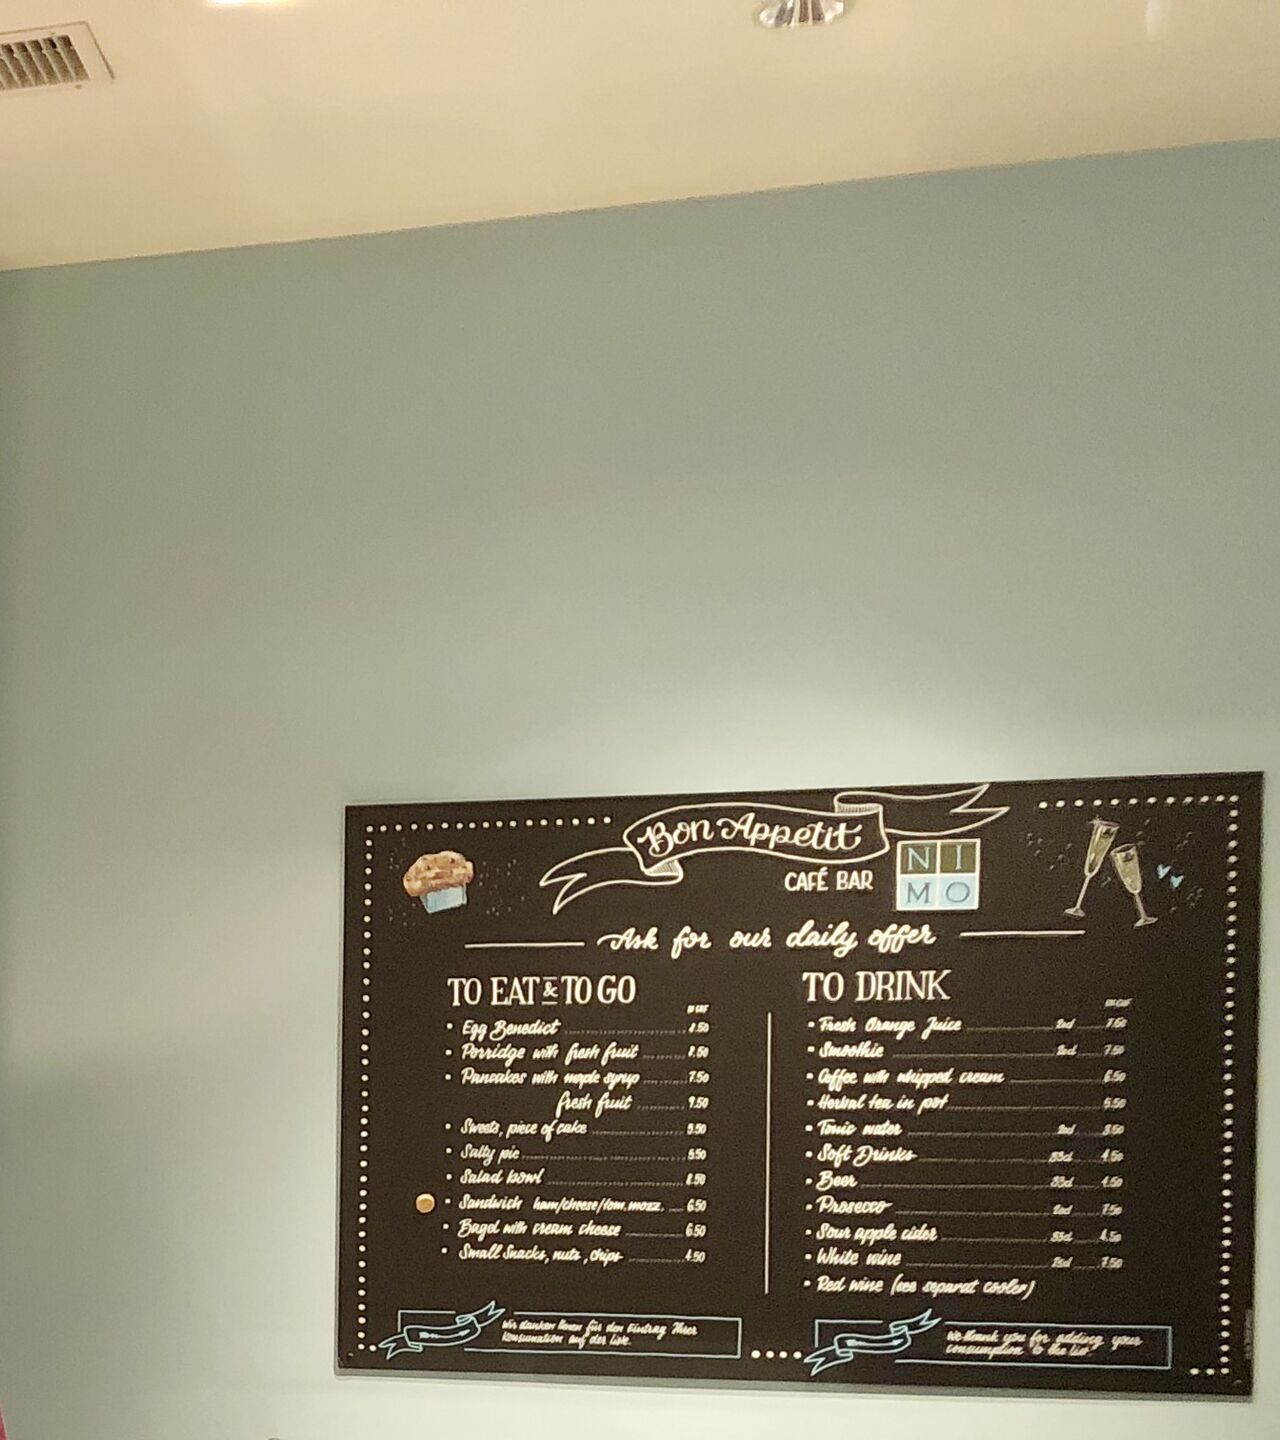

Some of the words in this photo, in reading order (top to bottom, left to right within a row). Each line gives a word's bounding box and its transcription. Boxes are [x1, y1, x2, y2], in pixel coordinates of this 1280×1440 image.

[637, 818, 715, 857] Bon
[716, 812, 863, 851] Appetit
[784, 867, 829, 892] CAFÉ
[836, 870, 874, 891] BAR
[597, 926, 660, 951] Ask
[670, 926, 712, 959] for
[729, 928, 772, 949] our
[785, 919, 858, 958] daily
[867, 923, 937, 953] offer
[447, 977, 482, 1006] TO
[490, 976, 539, 1006] EAT
[542, 979, 559, 999] &
[561, 976, 592, 1006] TO
[597, 975, 636, 1004] GO
[802, 971, 845, 1002] TO
[855, 969, 952, 1002] DRINK
[462, 1020, 487, 1041] Egg
[490, 1018, 561, 1041] Benedict
[818, 1016, 857, 1032] Fresh
[865, 1017, 916, 1040] Orange
[921, 1016, 962, 1040] Juice
[461, 1043, 526, 1067] Porridge
[532, 1045, 559, 1060] with
[565, 1041, 600, 1066] fresh
[601, 1041, 640, 1067] fruit
[818, 1040, 885, 1058] Smoothie
[460, 1067, 527, 1086] Pancakes
[531, 1070, 559, 1085] with
[563, 1070, 600, 1090] maple
[603, 1072, 640, 1091] syrup
[817, 1068, 858, 1092] Coffee
[863, 1069, 890, 1084] with
[896, 1068, 954, 1090] whipped
[958, 1070, 1005, 1084] cream
[556, 1091, 593, 1119] fresh
[595, 1092, 633, 1119] fruit
[817, 1093, 865, 1110] Herbal
[869, 1094, 894, 1110] tea
[896, 1094, 915, 1109] in
[917, 1094, 950, 1116] pot
[460, 1118, 504, 1138] Sweets,
[506, 1122, 538, 1139] piece
[540, 1120, 556, 1142] of
[556, 1120, 588, 1134] cake
[816, 1118, 857, 1136] Tonic
[861, 1119, 903, 1136] water
[460, 1143, 495, 1166] Salty
[497, 1145, 521, 1164] pie
[817, 1143, 852, 1168] Soft
[852, 1145, 918, 1167] Drinks
[459, 1168, 504, 1185] Salad
[506, 1168, 545, 1184] bowl
[815, 1170, 858, 1191] Beer
[458, 1194, 523, 1210] Sandwich
[815, 1194, 893, 1214] Prosecco
[457, 1218, 500, 1241] Bagel
[503, 1220, 528, 1235] with
[532, 1221, 573, 1236] cream
[578, 1220, 622, 1236] cheese
[816, 1222, 851, 1240] Sour
[853, 1222, 897, 1246] apple
[900, 1223, 938, 1241] cider
[458, 1243, 501, 1260] Small
[816, 1246, 859, 1266] White
[865, 1248, 902, 1266] wine
[816, 1275, 846, 1292] Red
[848, 1276, 884, 1292] wine
[982, 1277, 1037, 1300] cooler)
[1003, 1332, 1027, 1347] you
[1030, 1329, 1050, 1347] for
[1055, 1329, 1104, 1350] adding
